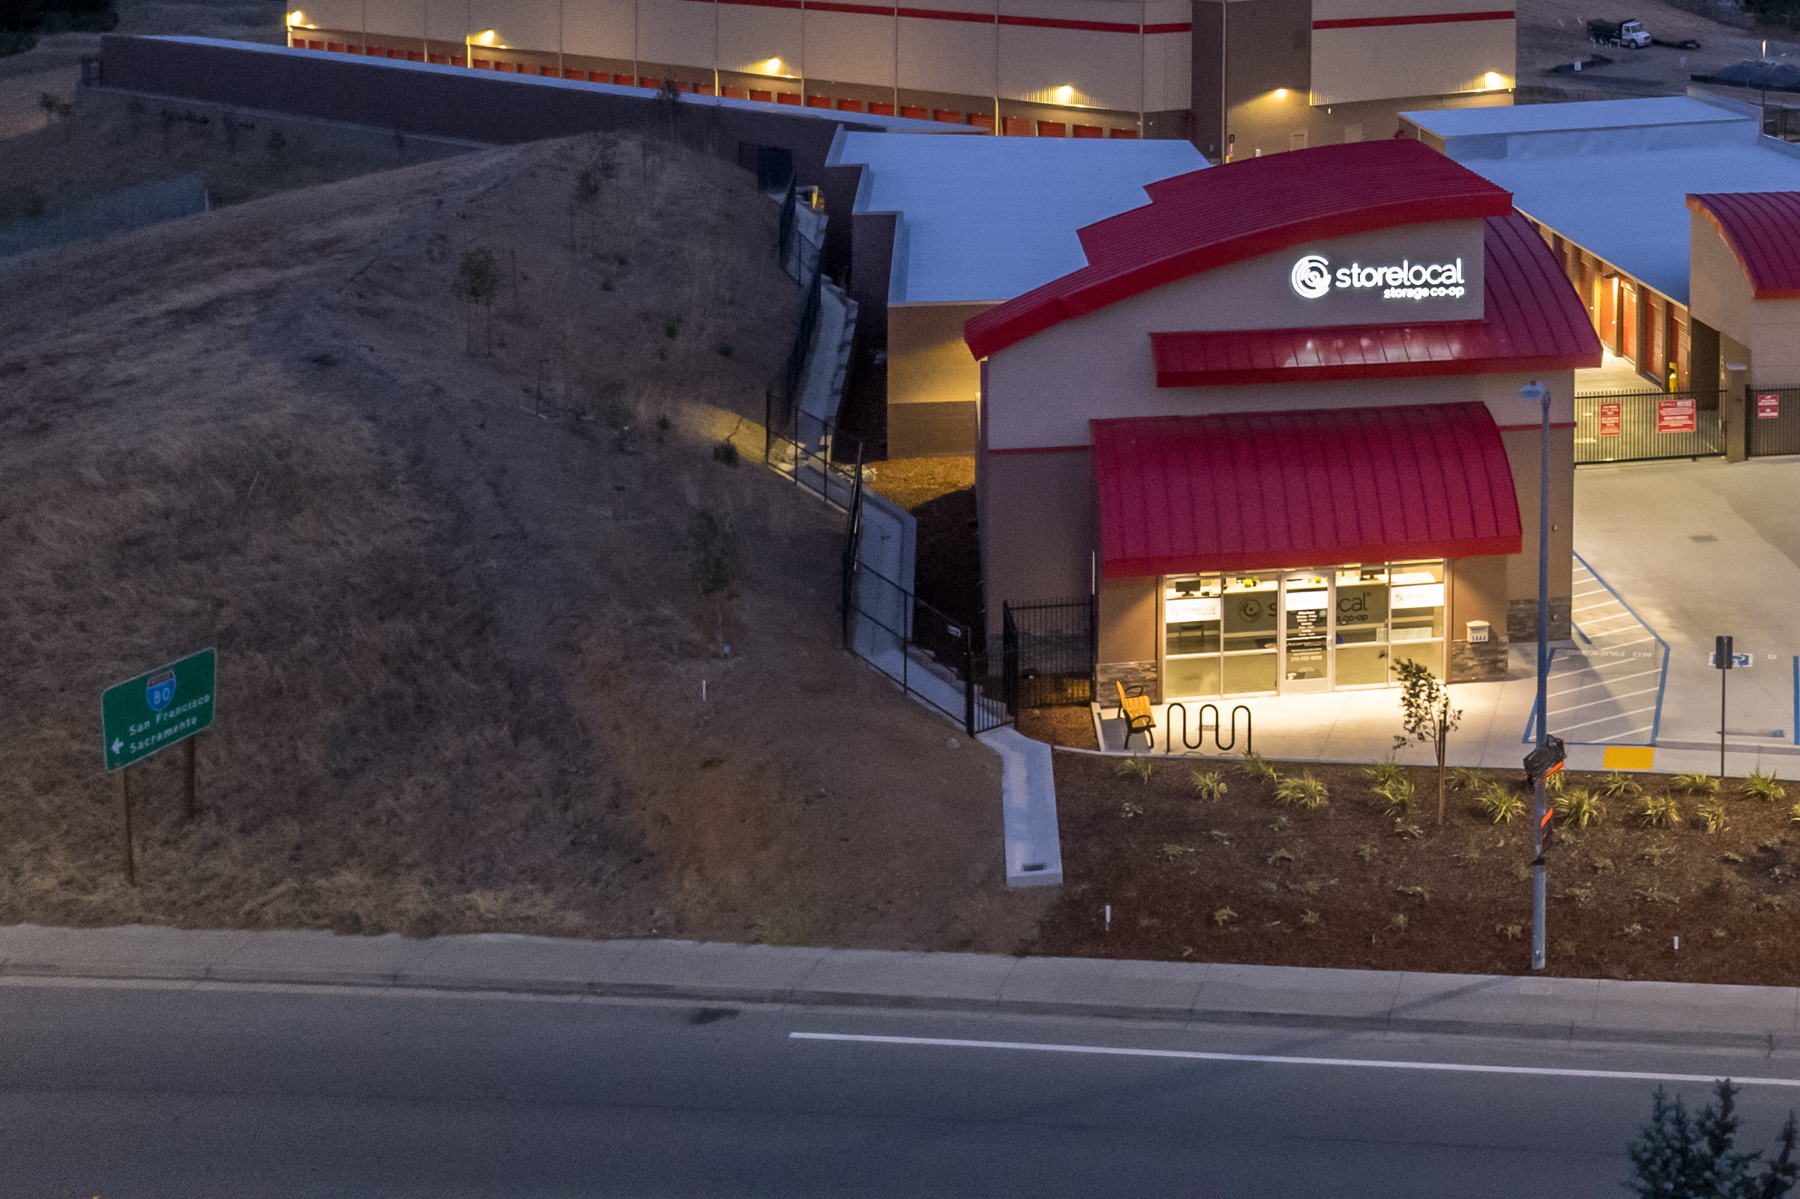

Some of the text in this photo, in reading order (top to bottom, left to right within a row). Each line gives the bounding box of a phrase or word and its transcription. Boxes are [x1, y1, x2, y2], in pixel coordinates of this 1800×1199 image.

[1335, 257, 1465, 288] storelocal
[1384, 285, 1465, 300] storage co-op
[154, 688, 170, 704] 80
[129, 694, 210, 736] San Francisco
[130, 717, 197, 753] Sacramento
